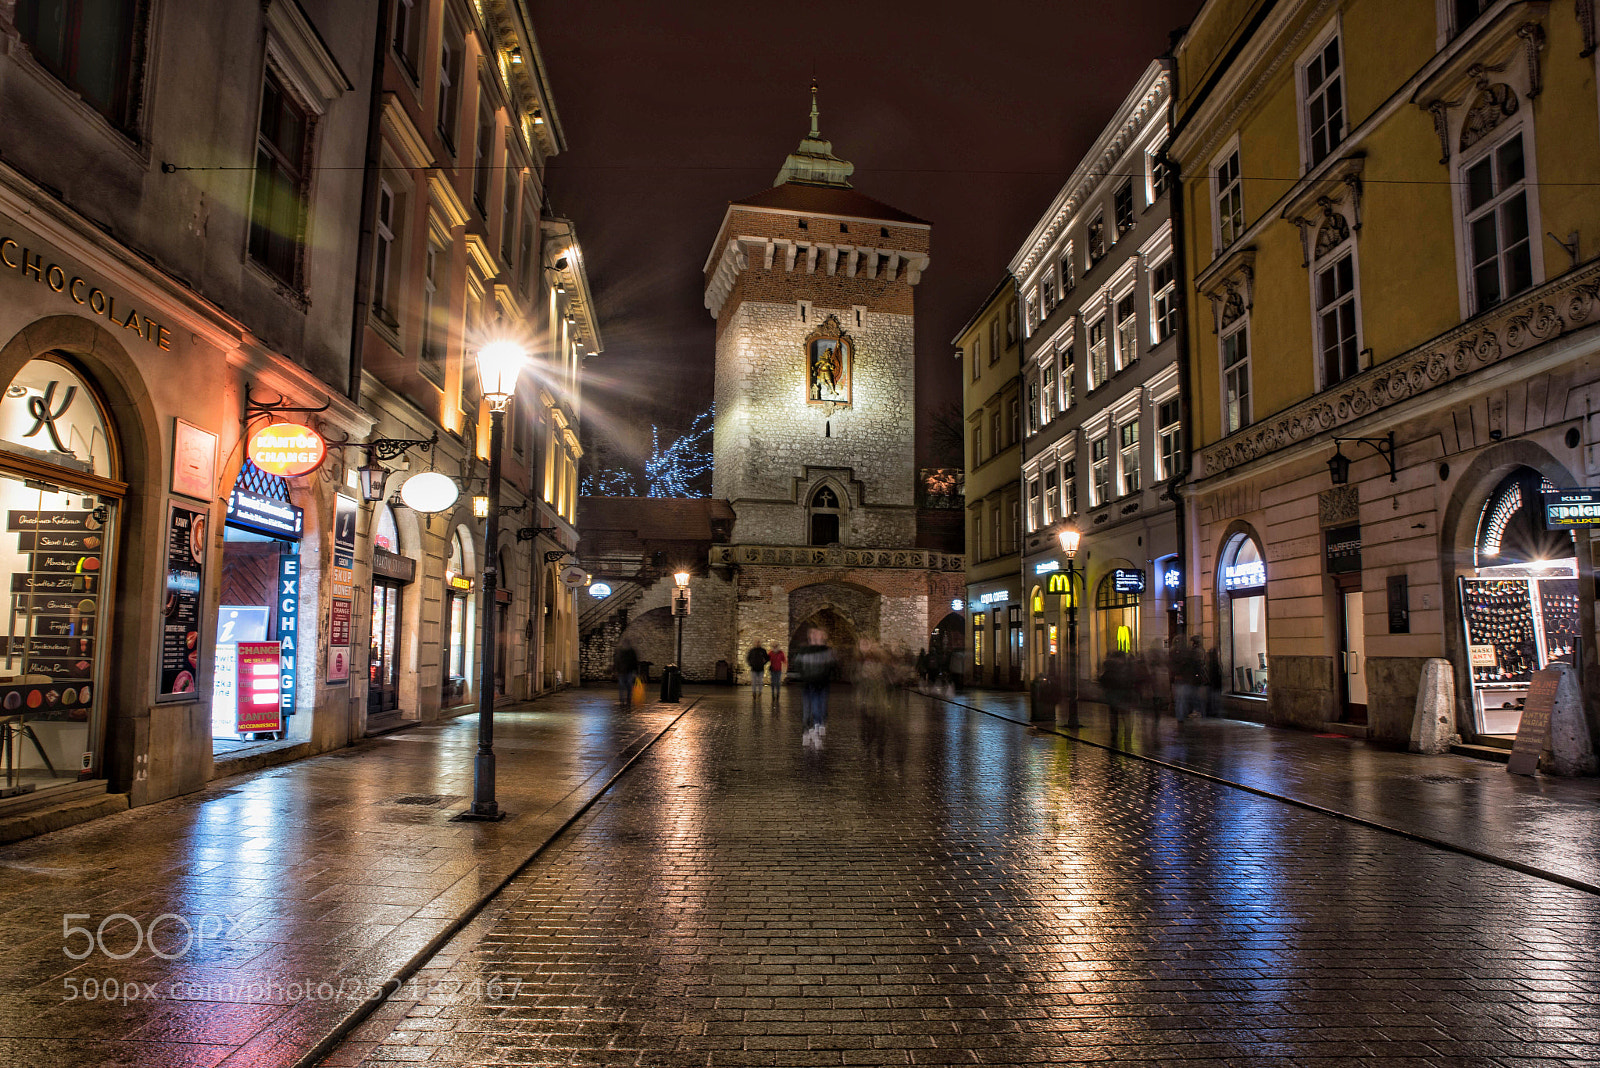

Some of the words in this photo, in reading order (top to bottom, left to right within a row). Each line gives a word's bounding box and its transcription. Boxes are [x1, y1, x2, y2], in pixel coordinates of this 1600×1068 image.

[0, 237, 171, 352] CHOCOLATE
[257, 434, 317, 448] KANTOR
[256, 452, 317, 463] CHANGE
[1328, 540, 1361, 553] HARPERS
[281, 560, 297, 708] EXCHANGE
[238, 646, 280, 655] CHANGE
[239, 711, 279, 721] KANTOR
